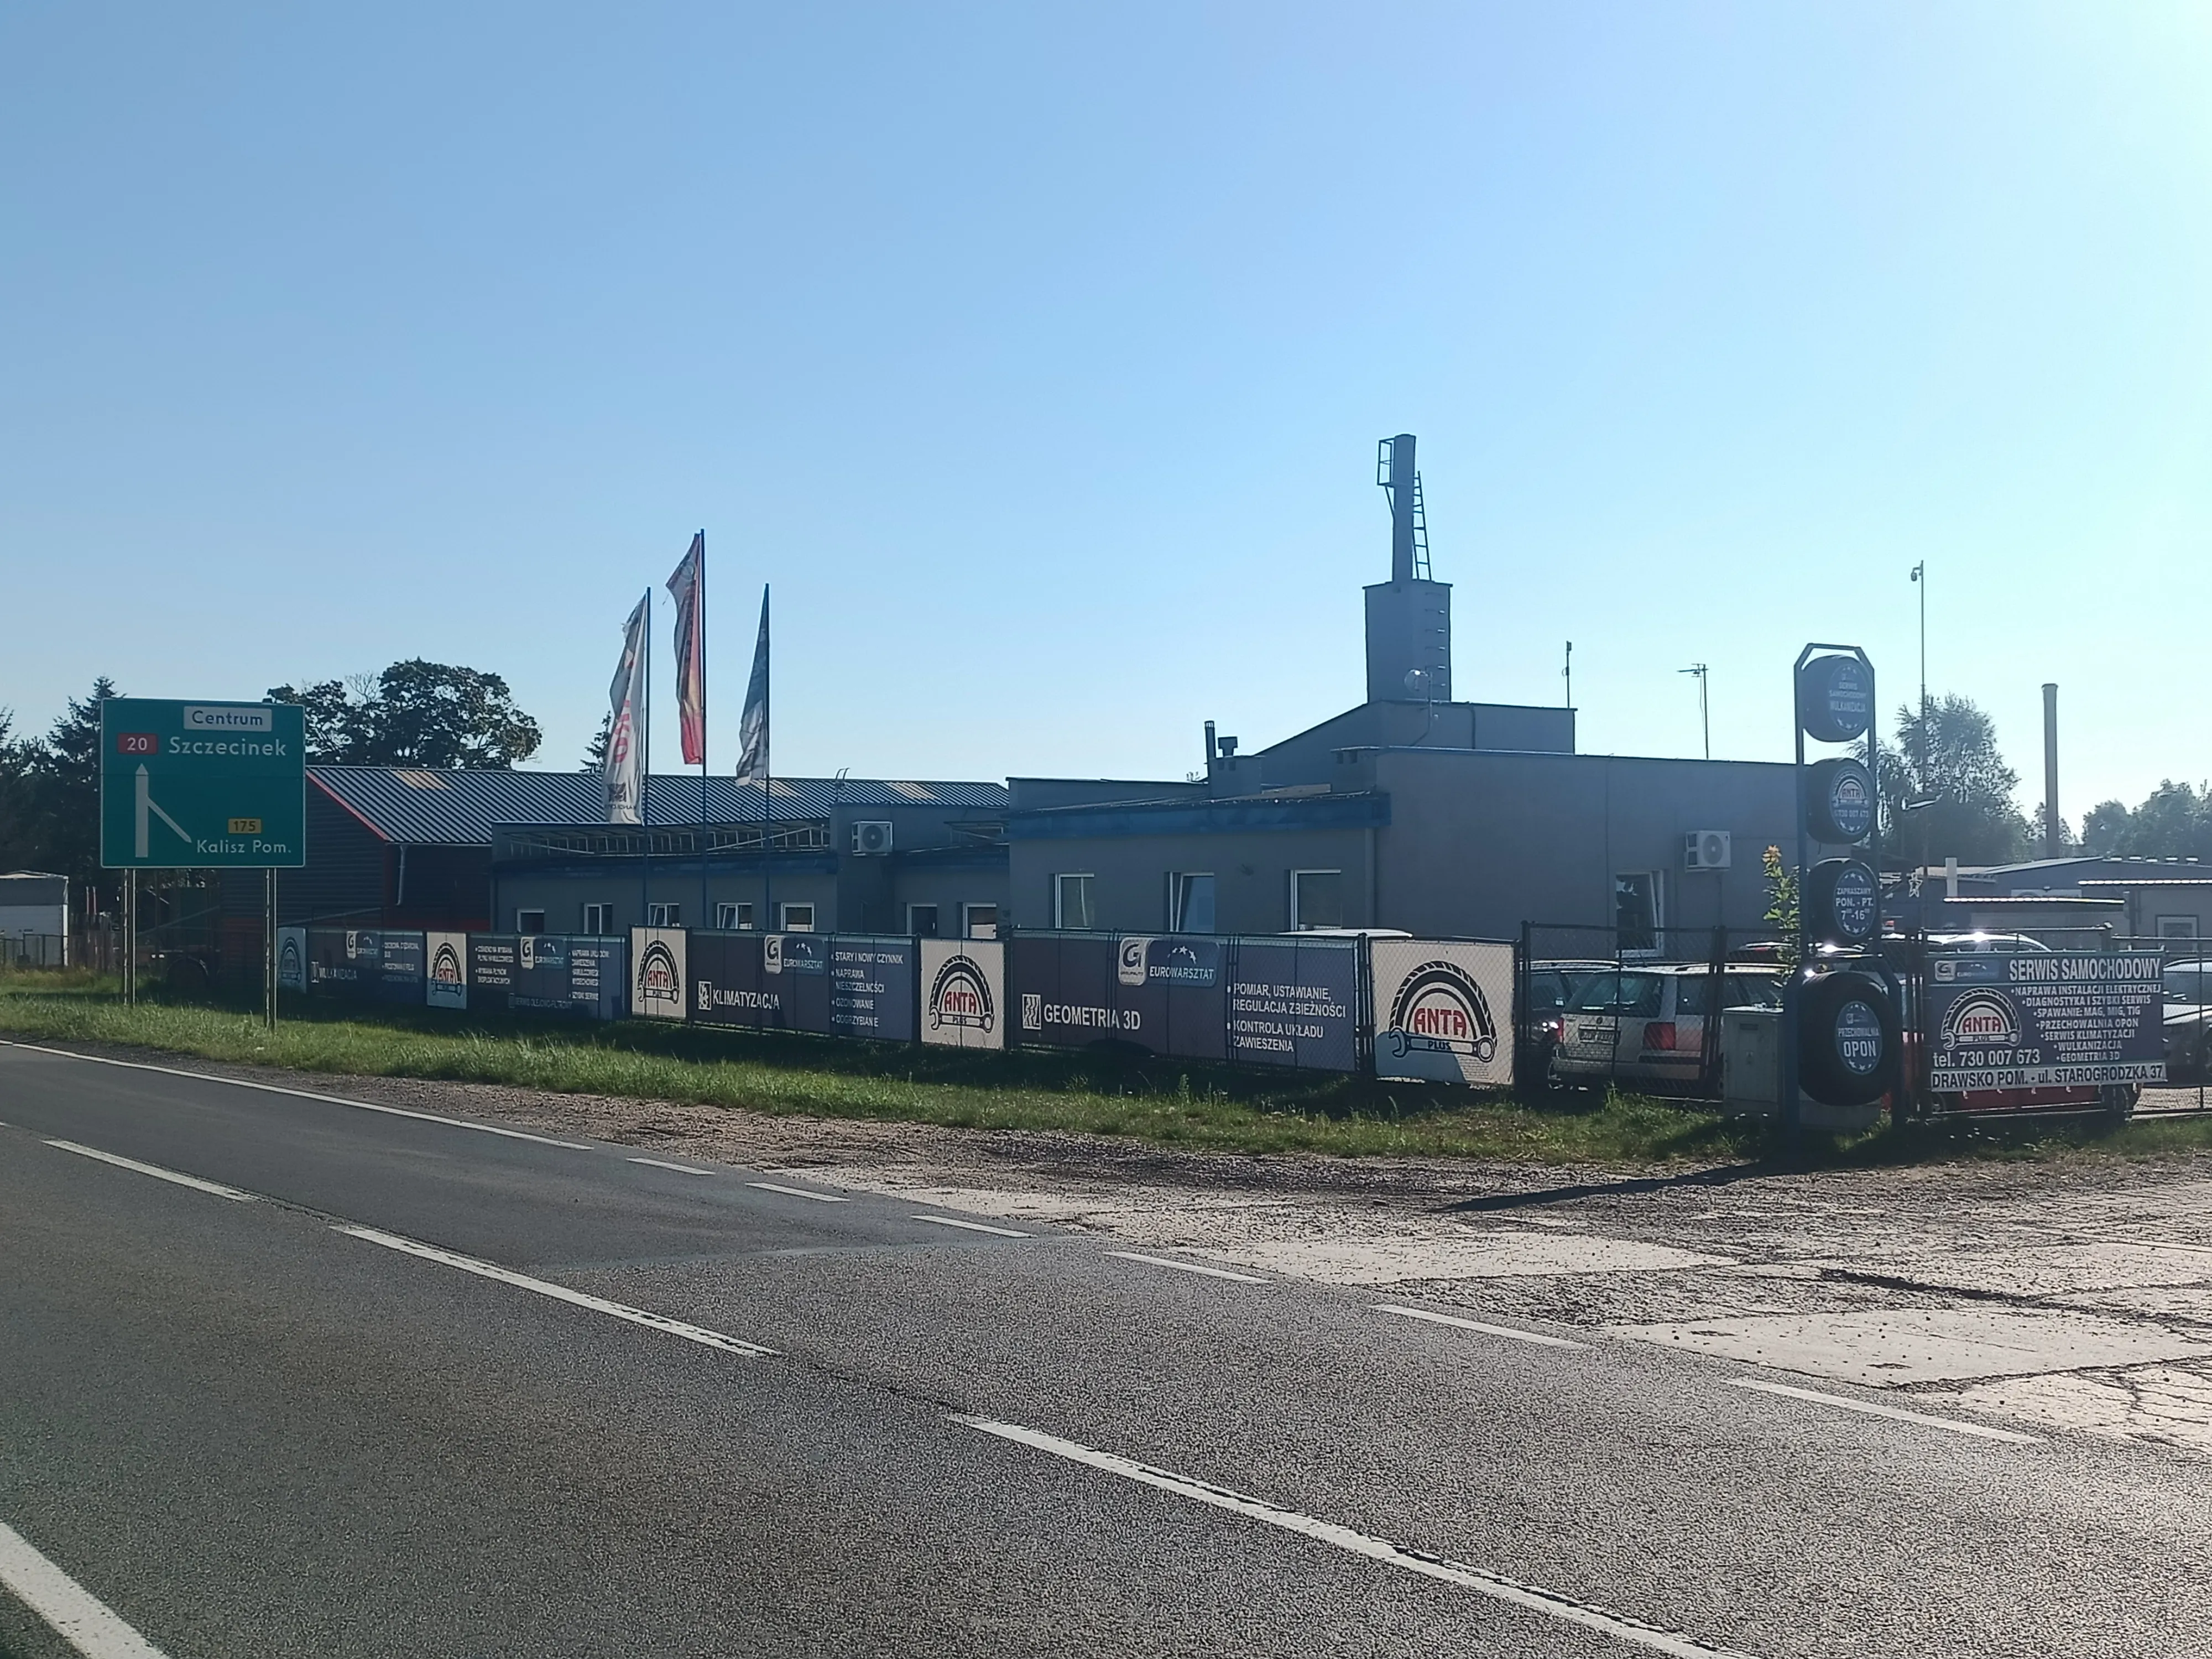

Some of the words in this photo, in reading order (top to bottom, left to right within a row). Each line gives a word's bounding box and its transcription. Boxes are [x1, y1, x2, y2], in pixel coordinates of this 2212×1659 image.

[191, 711, 264, 726] Centrum
[127, 737, 148, 752] 20
[169, 737, 286, 757] Szczecinek
[233, 821, 256, 832] 175
[196, 840, 246, 853] Kalisz
[253, 840, 291, 854] Pom.
[1835, 897, 1855, 907] PON.
[1861, 898, 1874, 906] PT.
[835, 951, 854, 962] STARY
[858, 952, 876, 962] NOWY
[877, 953, 903, 964] CZYNNIK
[836, 968, 865, 979] NAPRAWA
[1149, 966, 1214, 979] EUROWARSZTAT
[2009, 959, 2058, 982] SERWIS
[2062, 958, 2161, 980] SAMOCHODOWY
[648, 970, 669, 989] ANTA
[1234, 983, 1271, 998] POMIAR,
[1273, 984, 1331, 1002] USTAWIANIE,
[2015, 985, 2057, 996] NAPRAWA
[2059, 985, 2104, 995] INSTALACJI
[2106, 984, 2161, 994] ELEKTRYCZNEJ
[713, 989, 780, 1010] KLIMATYZACJA
[836, 998, 874, 1009] OZONOWANIE
[945, 991, 977, 1015] ANTA
[2026, 996, 2085, 1006] DIAGNOSTYKA
[2087, 997, 2090, 1005] I
[2092, 996, 2120, 1005] SZYBKI
[2122, 995, 2151, 1004] SERWIS
[1233, 999, 1288, 1014] REGULACJA
[1289, 1001, 1346, 1018] ZBIEŻNOŚCI
[2037, 1008, 2083, 1018] SPAWANIE:
[2084, 1007, 2105, 1018] MAG,
[2107, 1006, 2125, 1017] MIG,
[2127, 1006, 2141, 1015] TIG
[1044, 1004, 1120, 1029] GEOMETRIA
[1123, 1010, 1141, 1030] 3D
[1413, 1008, 1467, 1039] ANTA
[2040, 1019, 2113, 1030] PRZECHOWALNIA
[2115, 1018, 2138, 1027] OPON
[1233, 1020, 1284, 1035] KONTROLA
[1285, 1024, 1323, 1038] UKŁADU
[1962, 1016, 2002, 1034] ANTA
[2044, 1031, 2074, 1041] SERWIS
[2077, 1029, 2135, 1040] KLIMATYZACJI
[1233, 1035, 1294, 1052] ZAWIESZENIA
[1427, 1040, 1452, 1050] PLUS
[1843, 1040, 1876, 1057] OPON
[2058, 1041, 2122, 1051] WULKANIZACJA
[1933, 1051, 1955, 1067] tel.
[1959, 1051, 1984, 1067] 730
[1988, 1050, 2012, 1066] 007
[2017, 1048, 2041, 1065] 673
[2061, 1052, 2107, 1062] GEOMETRIA
[2110, 1052, 2120, 1061] 3D
[1932, 1071, 1994, 1088] DRAWSKO
[1997, 1070, 2028, 1086] POM.
[2038, 1069, 2052, 1084] ul.
[2054, 1065, 2147, 1083] STAROGRODZKA
[2150, 1065, 2163, 1079] 37
